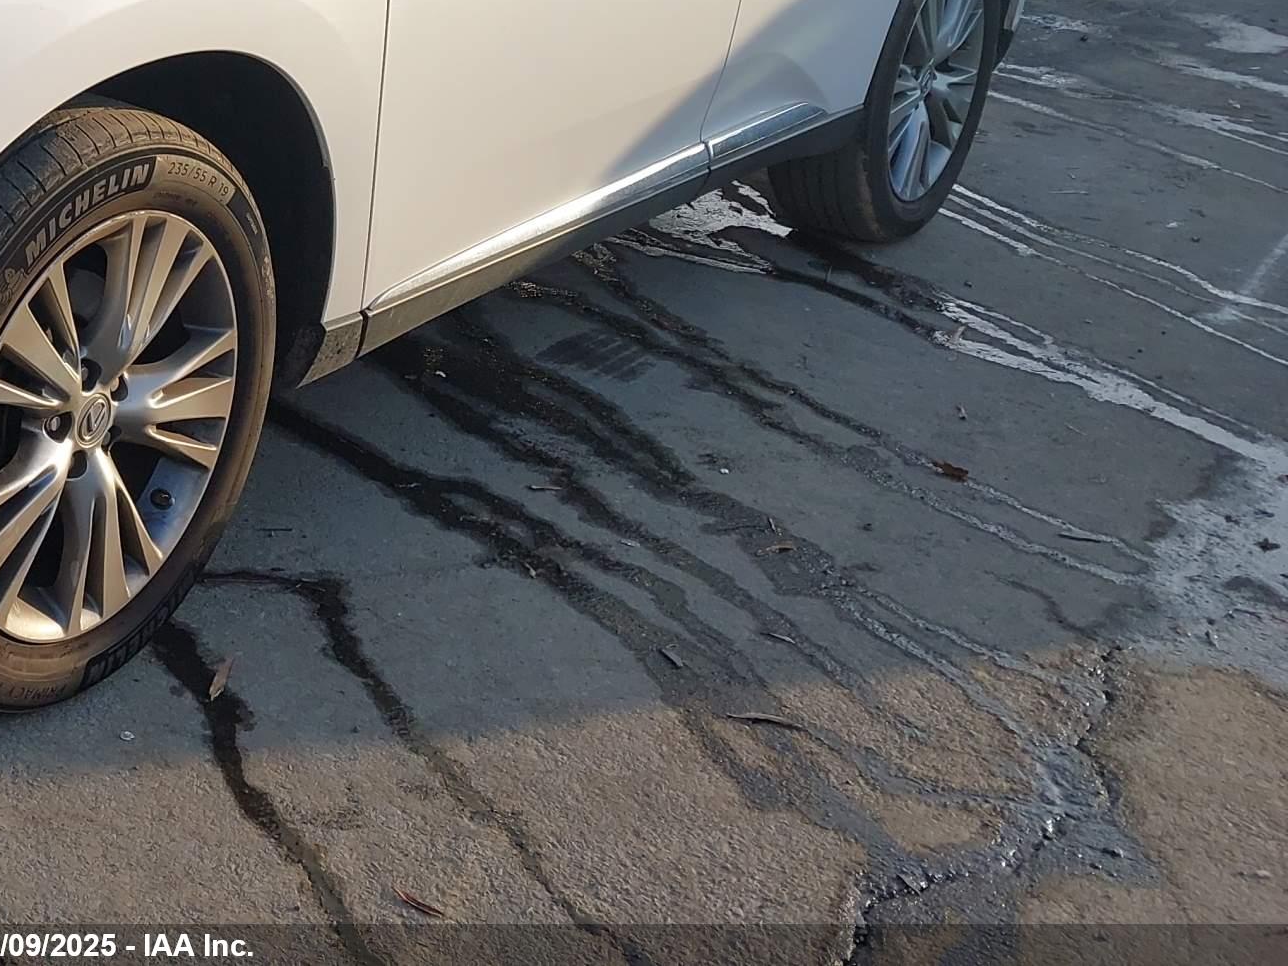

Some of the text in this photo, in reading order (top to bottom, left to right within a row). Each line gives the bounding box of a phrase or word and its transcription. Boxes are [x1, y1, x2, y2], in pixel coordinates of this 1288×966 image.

[167, 161, 230, 198] 235/55 R 19
[24, 163, 150, 267] MICHELIN
